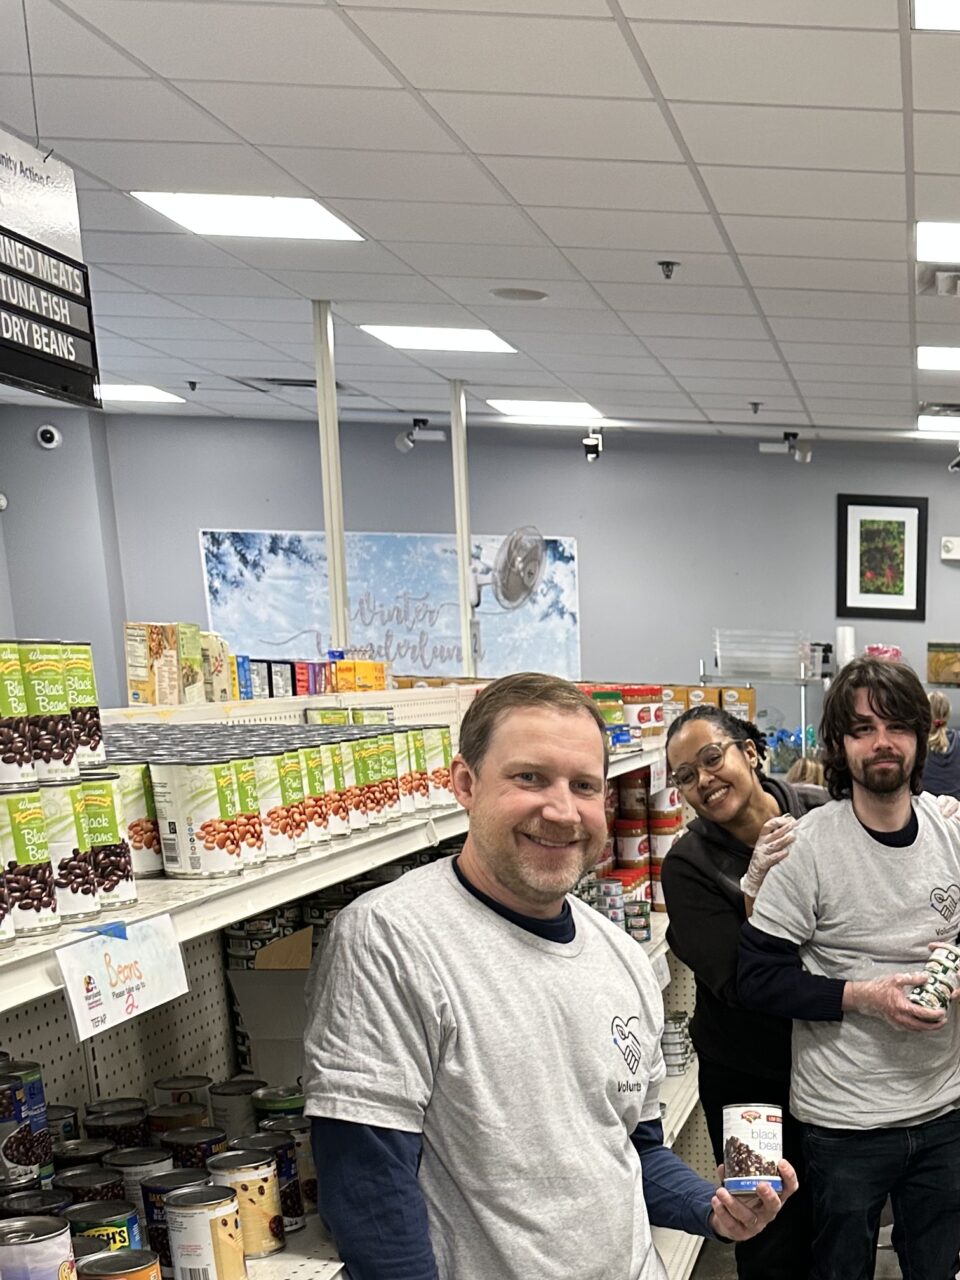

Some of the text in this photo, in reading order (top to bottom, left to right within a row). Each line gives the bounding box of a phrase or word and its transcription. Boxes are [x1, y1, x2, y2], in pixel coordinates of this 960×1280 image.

[38, 251, 82, 294] MEATS
[0, 275, 71, 326] TUNA FISH
[1, 313, 76, 361] DRY BEANS
[32, 680, 65, 697] Black
[104, 952, 143, 988] Beans
[125, 992, 138, 1015] 2
[751, 1128, 778, 1140] black
